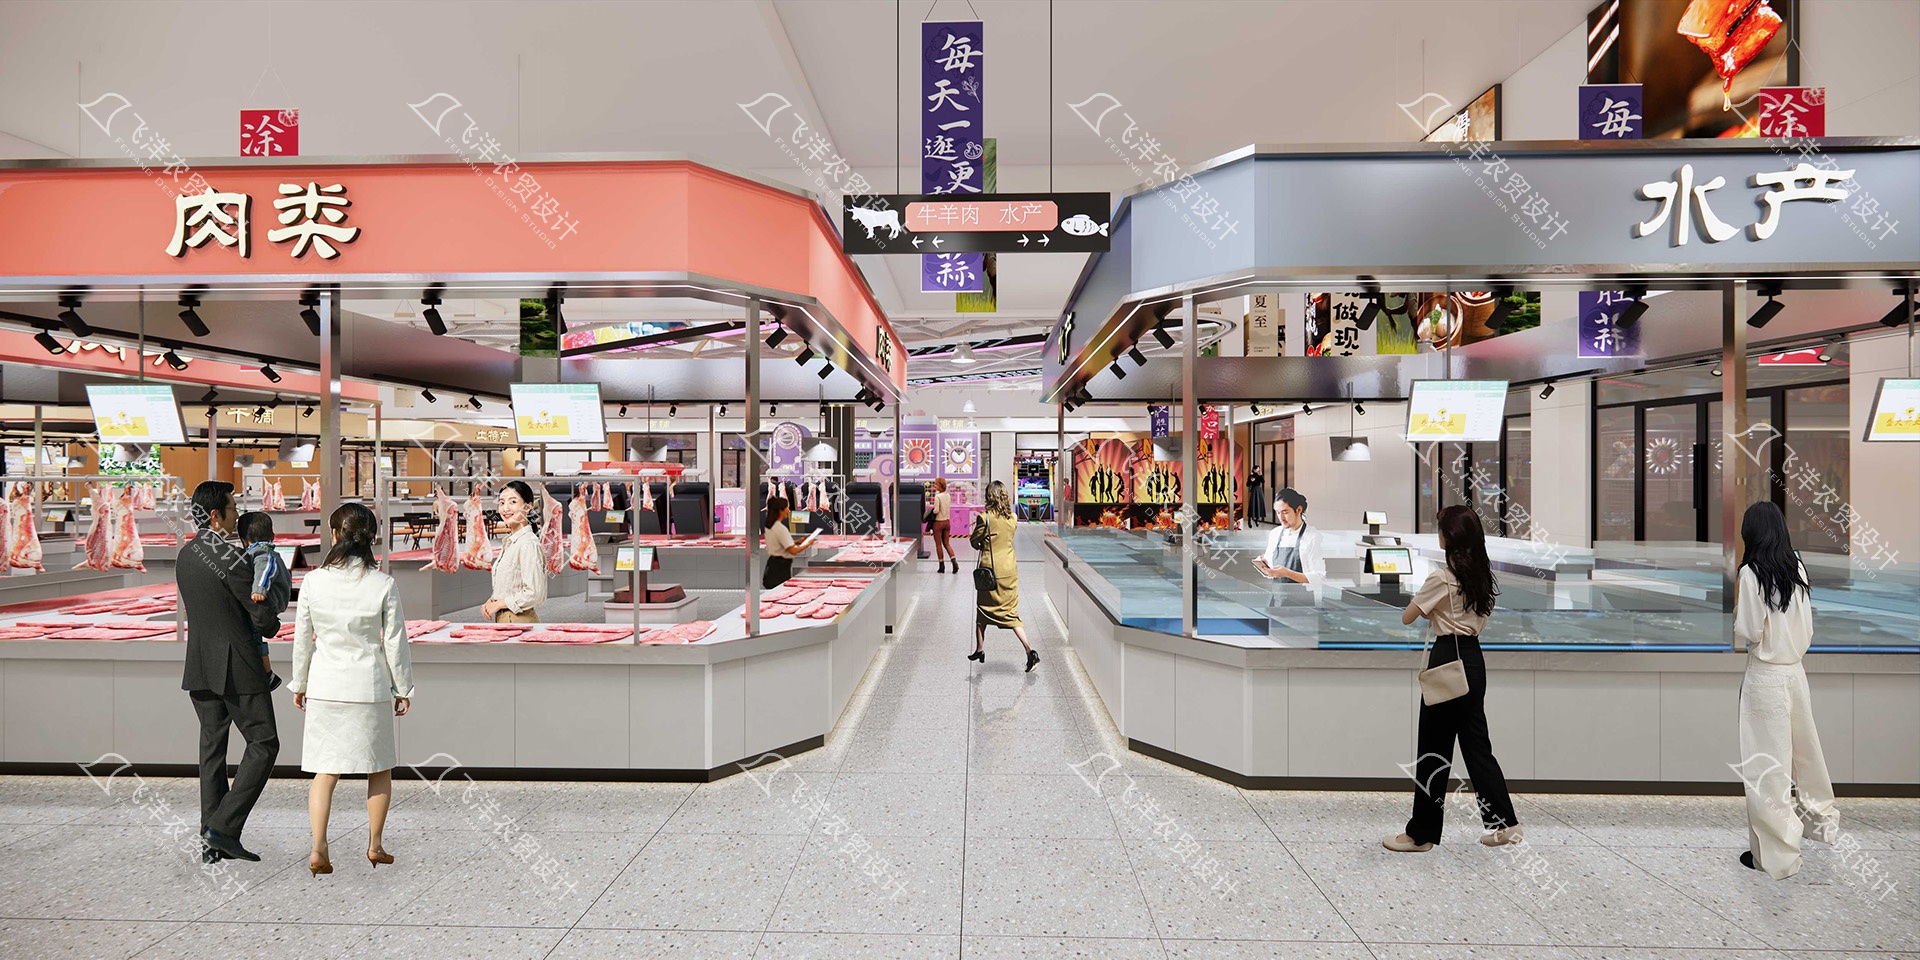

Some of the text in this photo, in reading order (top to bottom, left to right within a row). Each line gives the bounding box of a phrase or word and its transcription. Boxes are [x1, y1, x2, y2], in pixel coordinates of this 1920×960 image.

[165, 182, 361, 258] 肉类
[917, 203, 1042, 225] 牛羊肉 水产
[1636, 163, 1856, 247] 水产
[1254, 295, 1267, 328] 夏至
